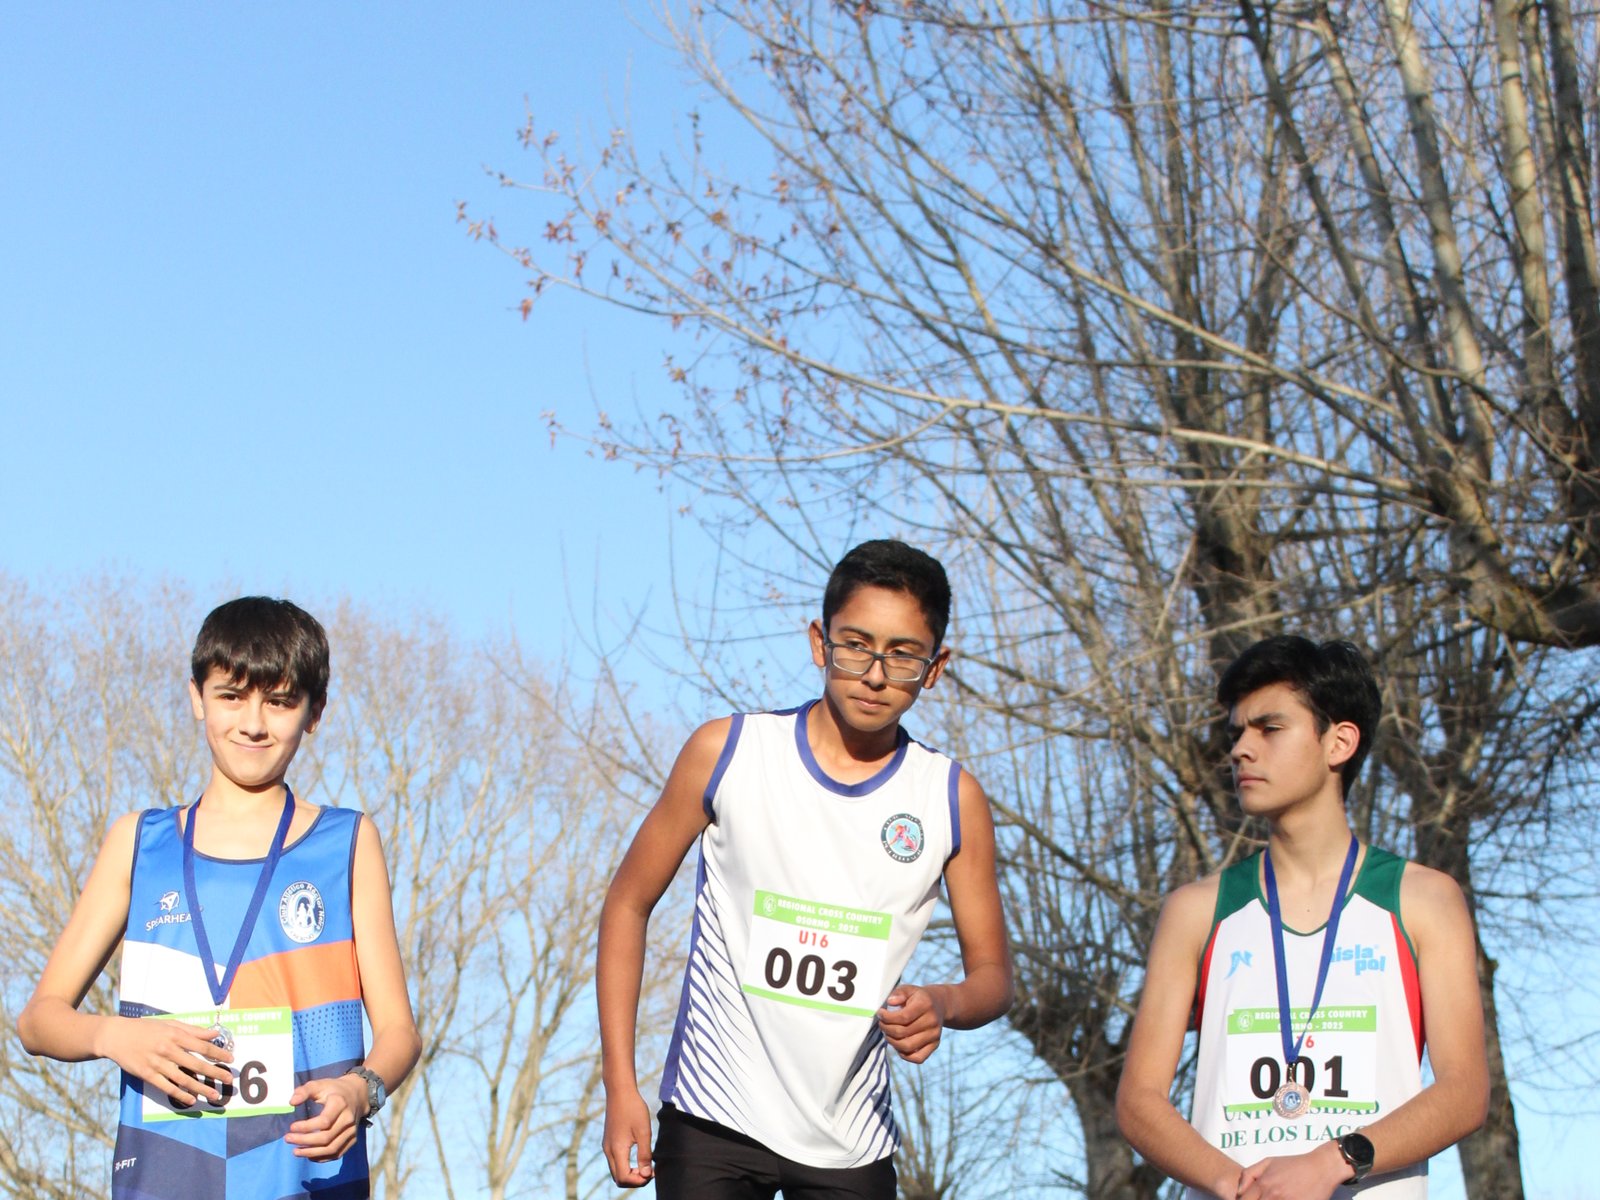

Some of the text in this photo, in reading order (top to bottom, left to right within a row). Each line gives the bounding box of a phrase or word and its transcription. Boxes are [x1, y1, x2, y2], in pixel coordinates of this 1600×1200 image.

[145, 912, 192, 931] SPEARHEA
[777, 899, 883, 925] REGIONAL CROSS COUNTRY
[795, 915, 830, 929] OSORNO
[838, 923, 860, 934] 2025
[798, 930, 829, 949] U16
[764, 947, 858, 1002] 003
[1355, 956, 1386, 976] pol
[1328, 1010, 1368, 1018] COUNTRY
[1321, 1022, 1344, 1030] 2025
[1250, 1055, 1349, 1100] 001
[1220, 1130, 1247, 1149] DE
[1254, 1125, 1298, 1144] LOS
